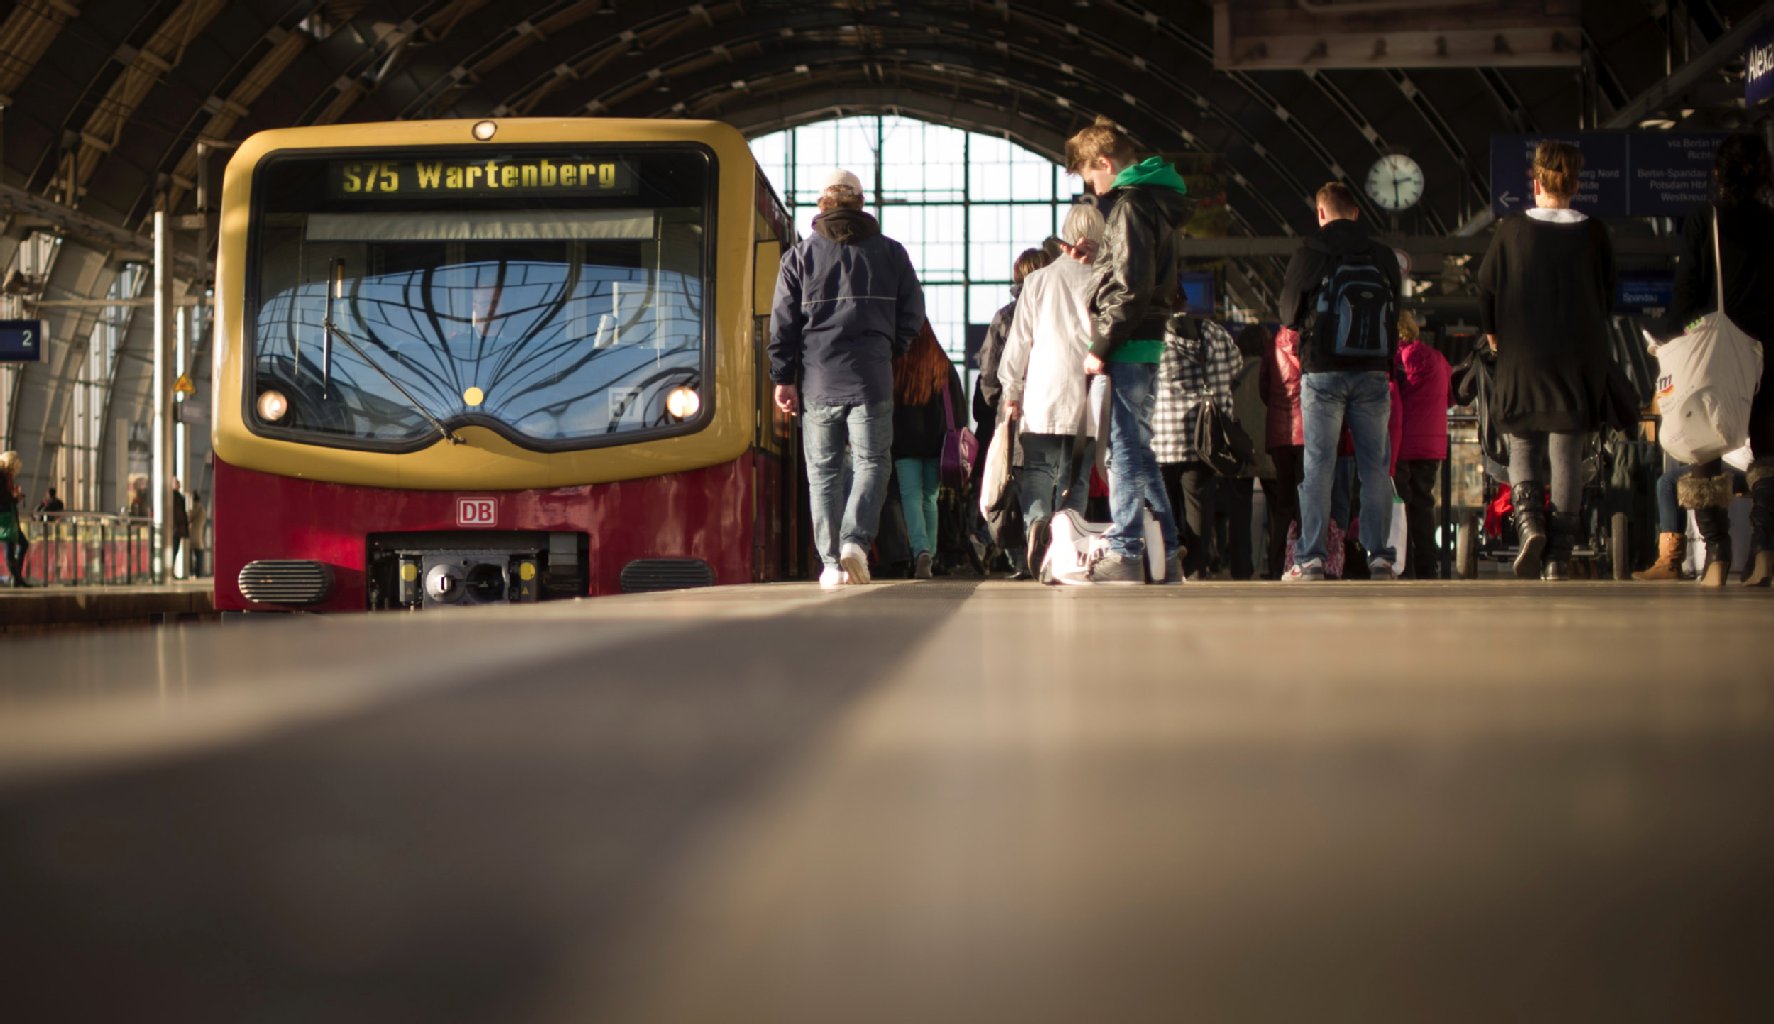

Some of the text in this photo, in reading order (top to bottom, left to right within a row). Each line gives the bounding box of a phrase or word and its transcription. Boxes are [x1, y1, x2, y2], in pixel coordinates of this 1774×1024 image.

[1747, 43, 1774, 83] Alexa
[1667, 139, 1681, 148] via
[1683, 138, 1709, 148] Berlin
[343, 159, 616, 192] S75 Wartenberg
[1598, 168, 1620, 178] Nord
[1637, 168, 1707, 180] Berlin-Spandau
[1650, 180, 1689, 190] Potsdam
[22, 329, 33, 348] 2
[610, 392, 638, 417] 57
[462, 502, 492, 522] DB
